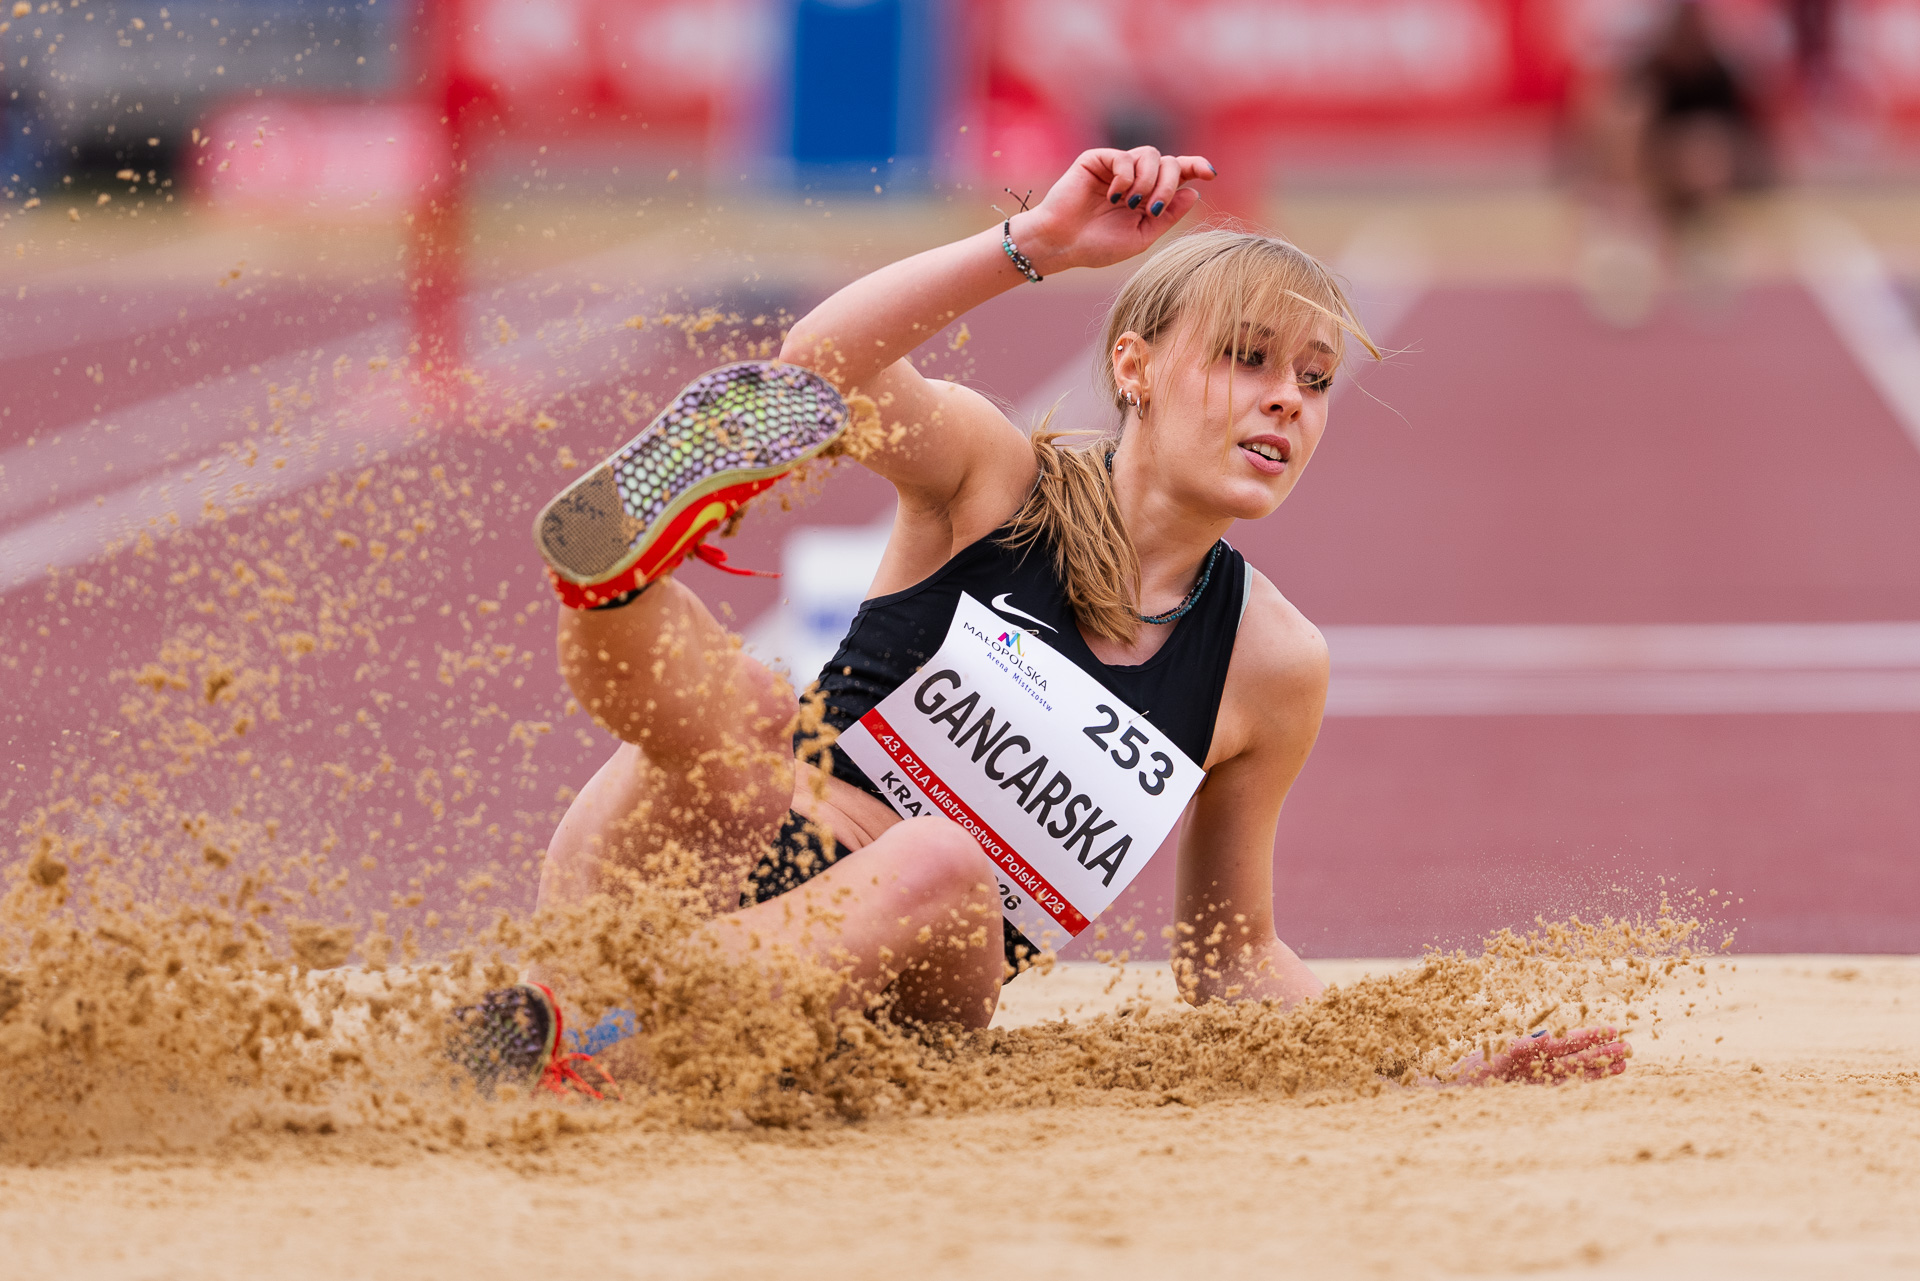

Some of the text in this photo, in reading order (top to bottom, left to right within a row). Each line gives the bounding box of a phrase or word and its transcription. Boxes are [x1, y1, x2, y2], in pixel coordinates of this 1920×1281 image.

[963, 621, 1048, 692] MAŁOPOLSKA
[986, 652, 1053, 712] Arena Mistrzostw
[914, 669, 1133, 888] GANCARSKA
[1082, 703, 1174, 796] 253
[880, 770, 932, 817] KRA
[881, 735, 1066, 915] 43. PZLA Mistrzostwa Polski U23
